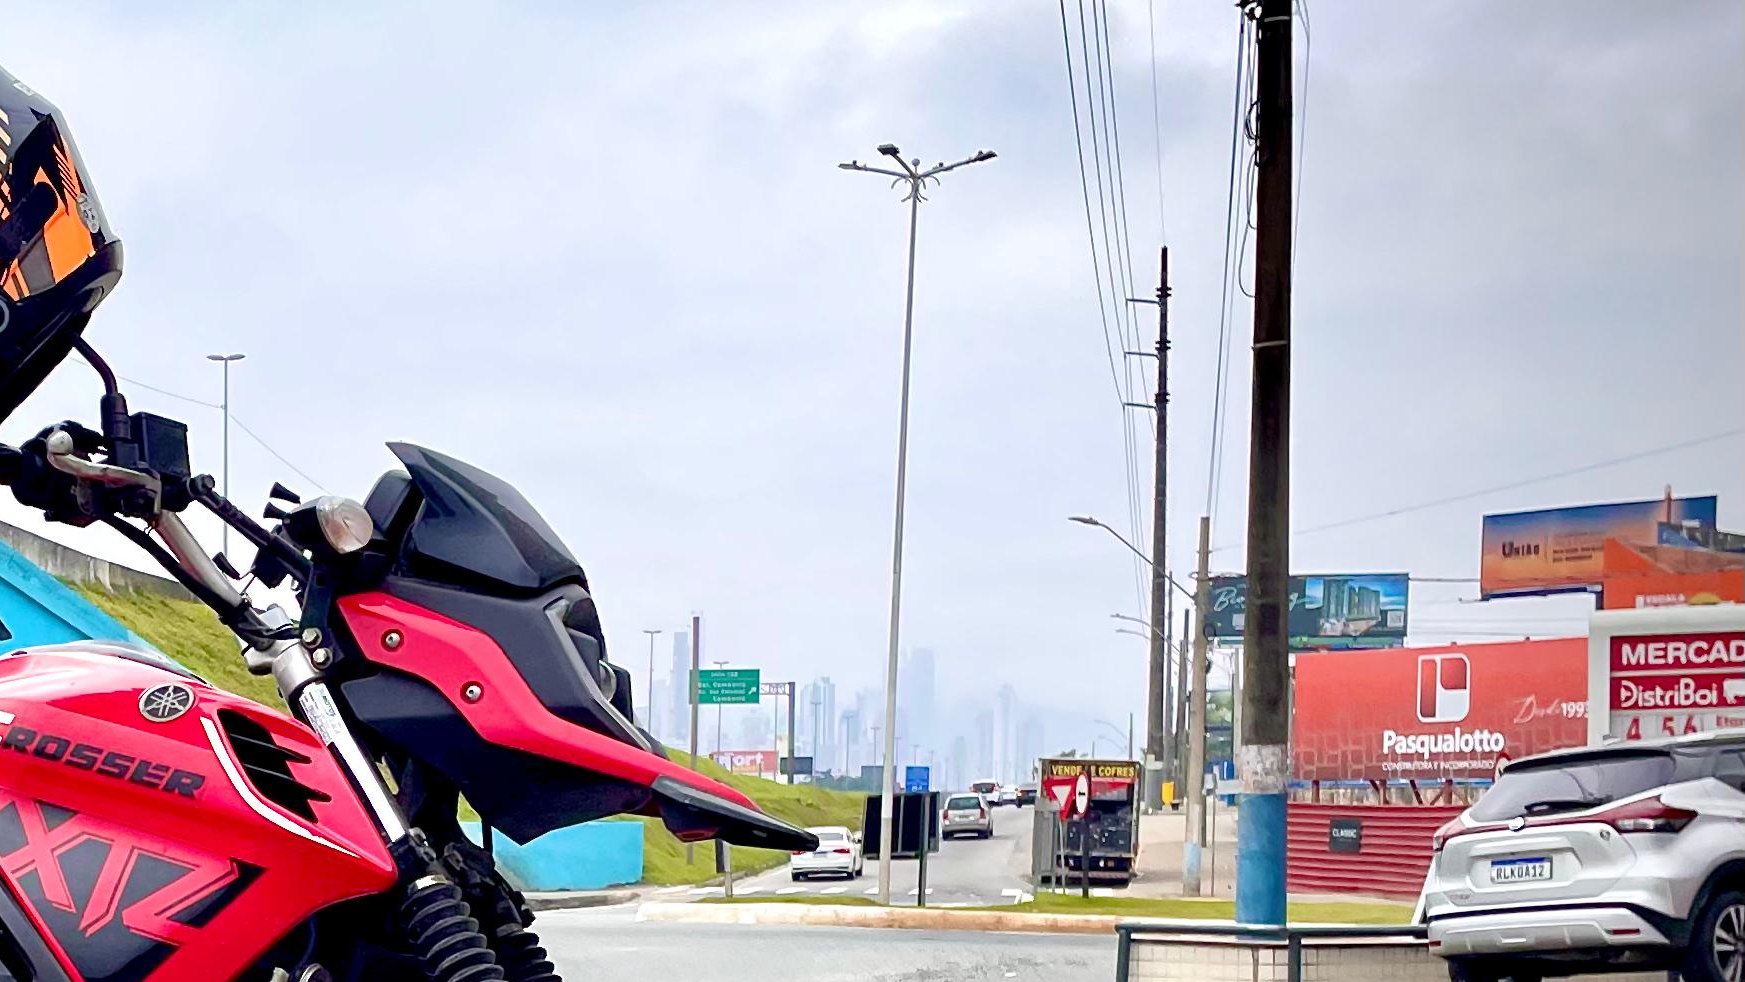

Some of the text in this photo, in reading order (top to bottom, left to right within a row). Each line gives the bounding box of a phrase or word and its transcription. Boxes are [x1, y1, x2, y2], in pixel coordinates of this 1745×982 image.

[1620, 677, 1719, 708] DistriBoi
[1383, 726, 1505, 760] Pasqualotto
[1099, 766, 1135, 777] COFRES
